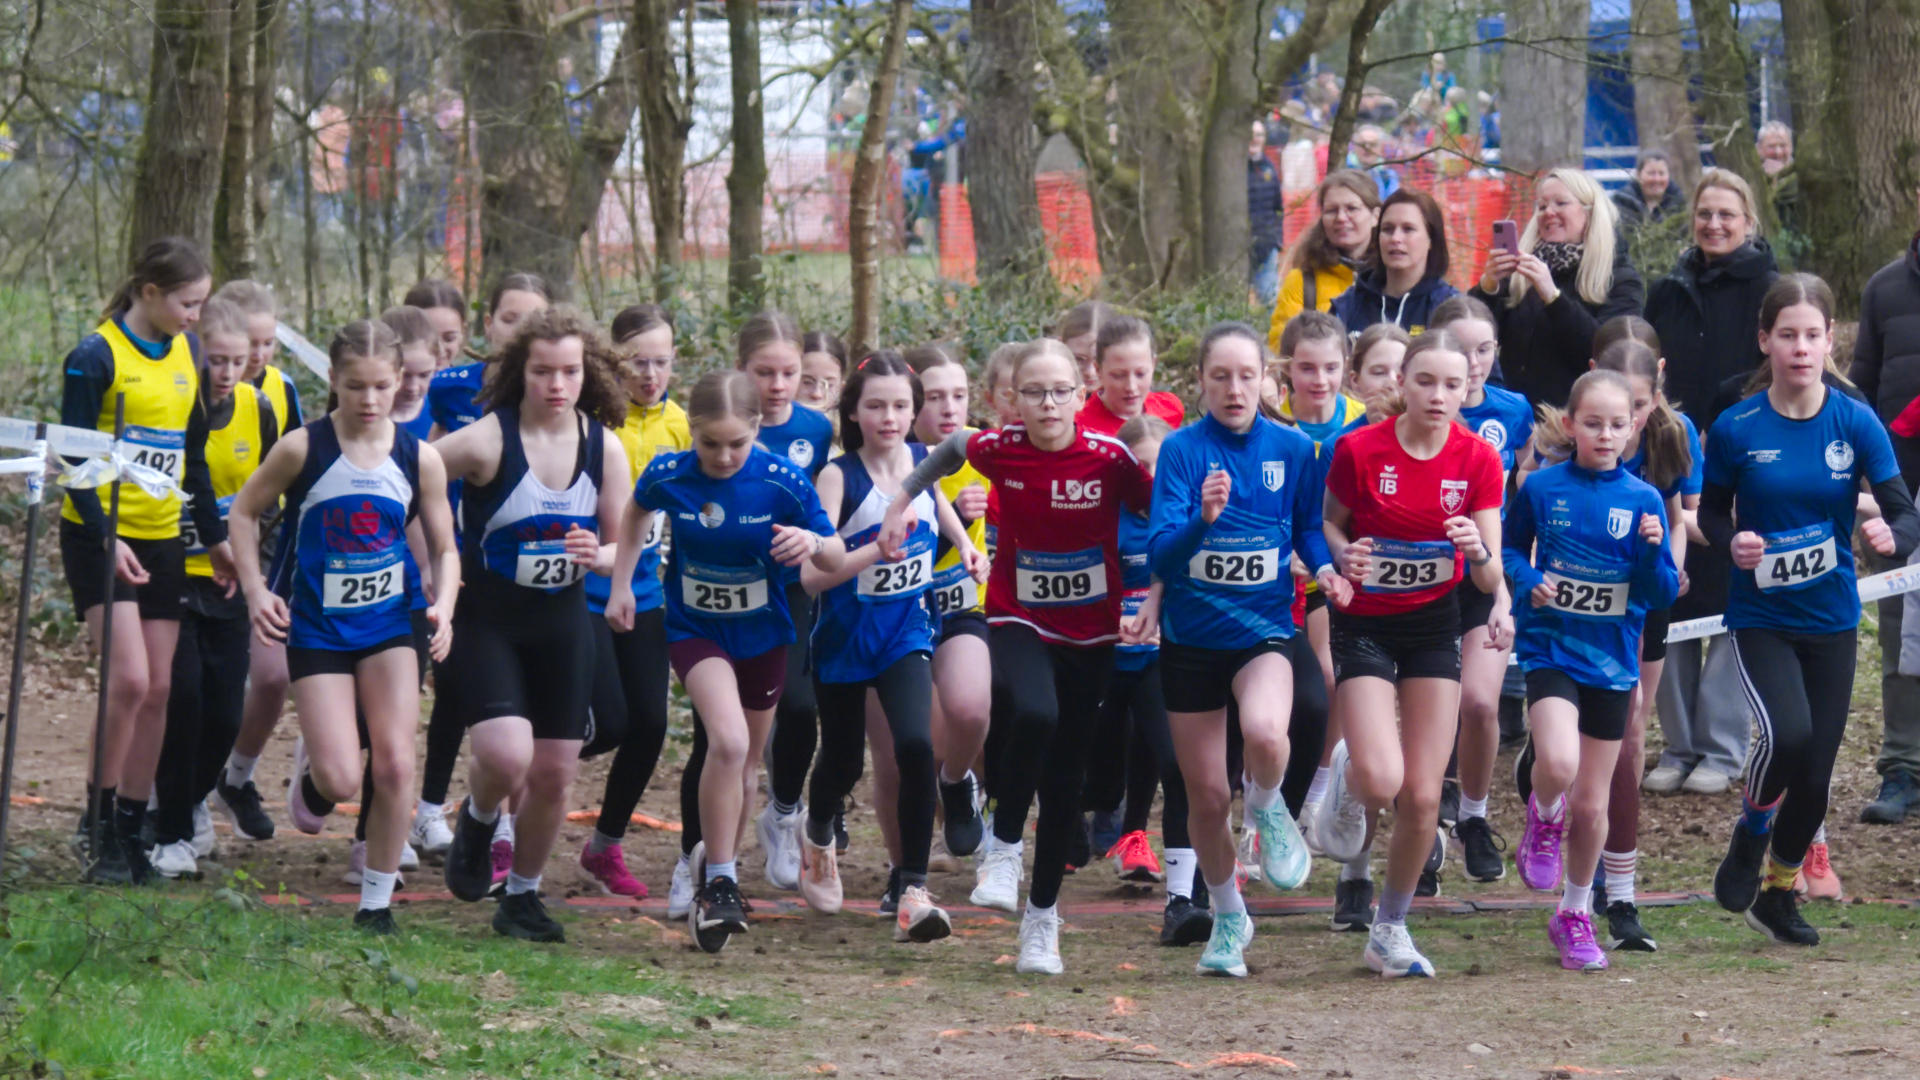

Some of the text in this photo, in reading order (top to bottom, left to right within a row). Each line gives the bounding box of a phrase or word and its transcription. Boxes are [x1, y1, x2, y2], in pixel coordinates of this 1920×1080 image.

[1379, 479, 1397, 495] IB
[1051, 500, 1101, 509] Rosendahl
[1212, 536, 1246, 544] Volksbank
[532, 556, 580, 585] 231
[873, 559, 922, 593] 232
[1205, 554, 1264, 581] 626
[1378, 561, 1437, 586] 293
[1771, 548, 1826, 582] 442
[341, 571, 392, 604] 252
[695, 584, 748, 610] 251
[1032, 573, 1091, 599] 309
[1554, 580, 1614, 613] 625
